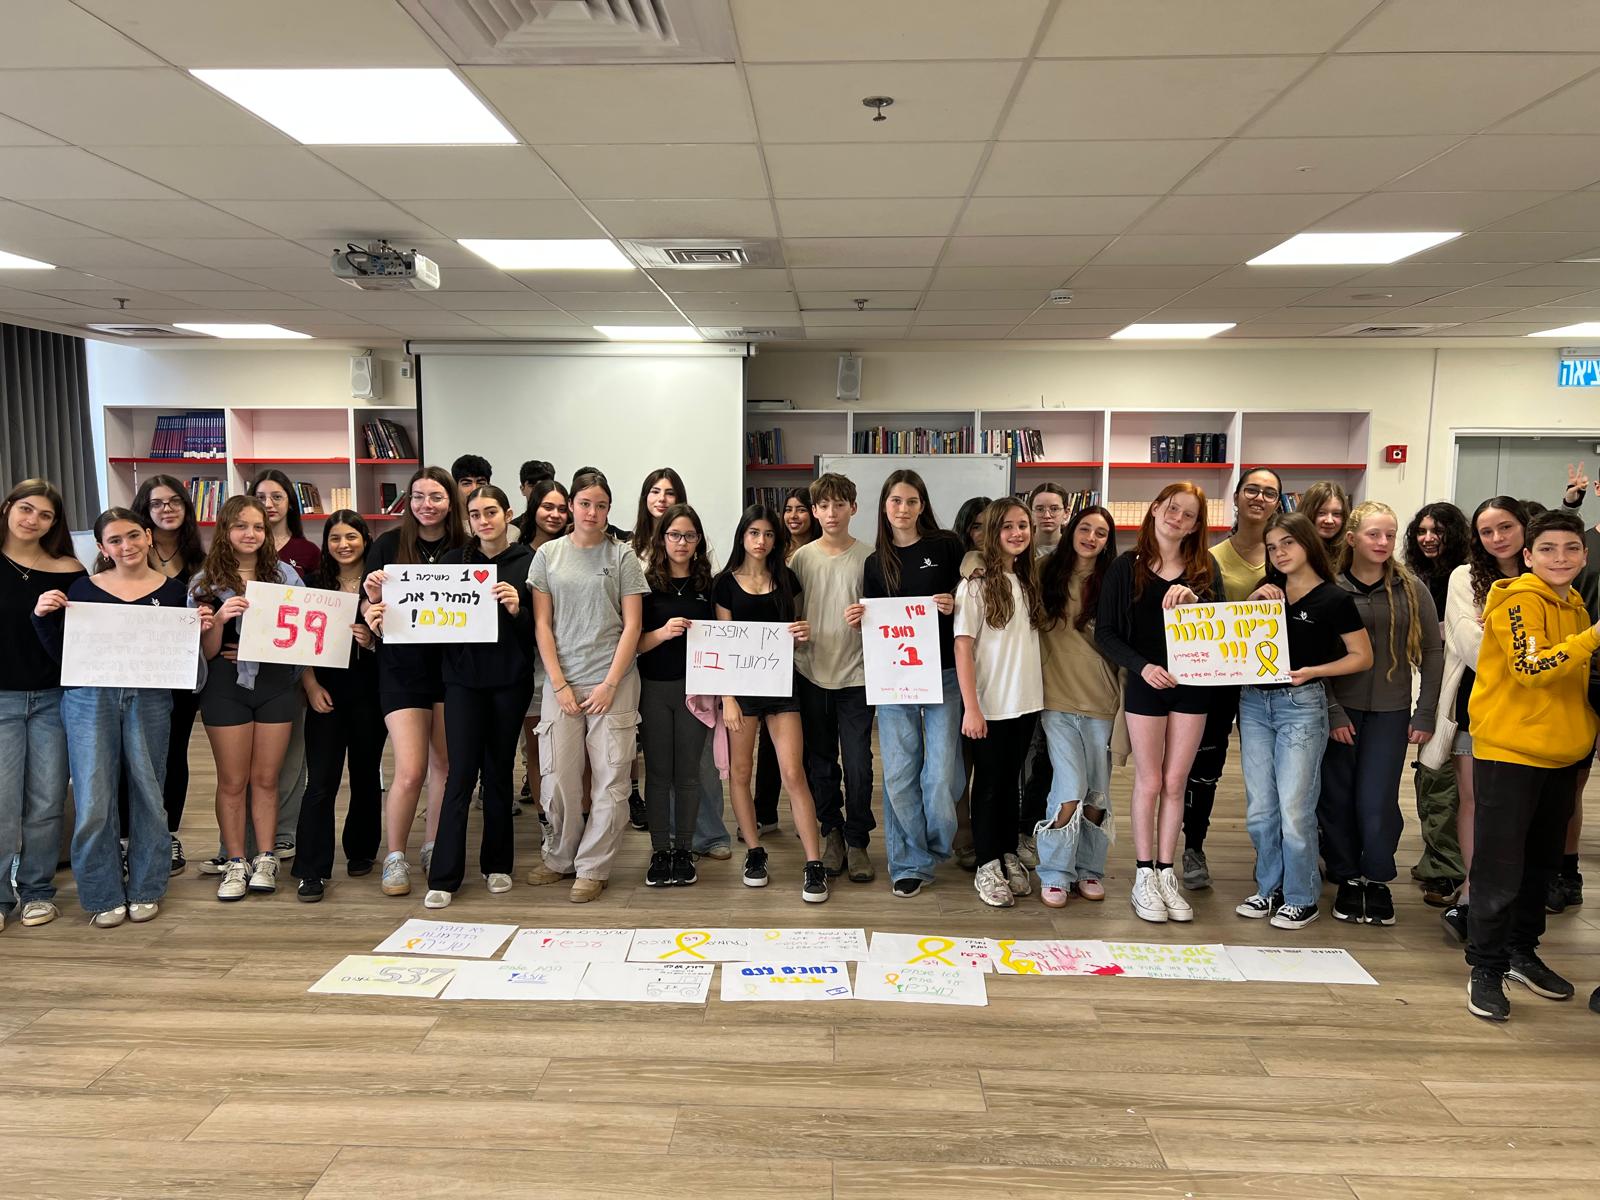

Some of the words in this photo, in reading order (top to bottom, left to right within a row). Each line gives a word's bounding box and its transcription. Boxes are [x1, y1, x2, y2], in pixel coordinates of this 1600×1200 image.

[400, 570, 410, 582] 1
[416, 573, 450, 581] משימה
[460, 569, 470, 582] 1
[399, 592, 424, 605] את
[430, 590, 480, 605] להחזיר
[1174, 606, 1216, 623] עדיין
[1225, 602, 1283, 617] השיעור
[273, 605, 328, 655] 59
[702, 624, 749, 639] אופציה
[879, 625, 916, 639] מועד
[761, 627, 780, 650] אין
[728, 652, 780, 670] למועד
